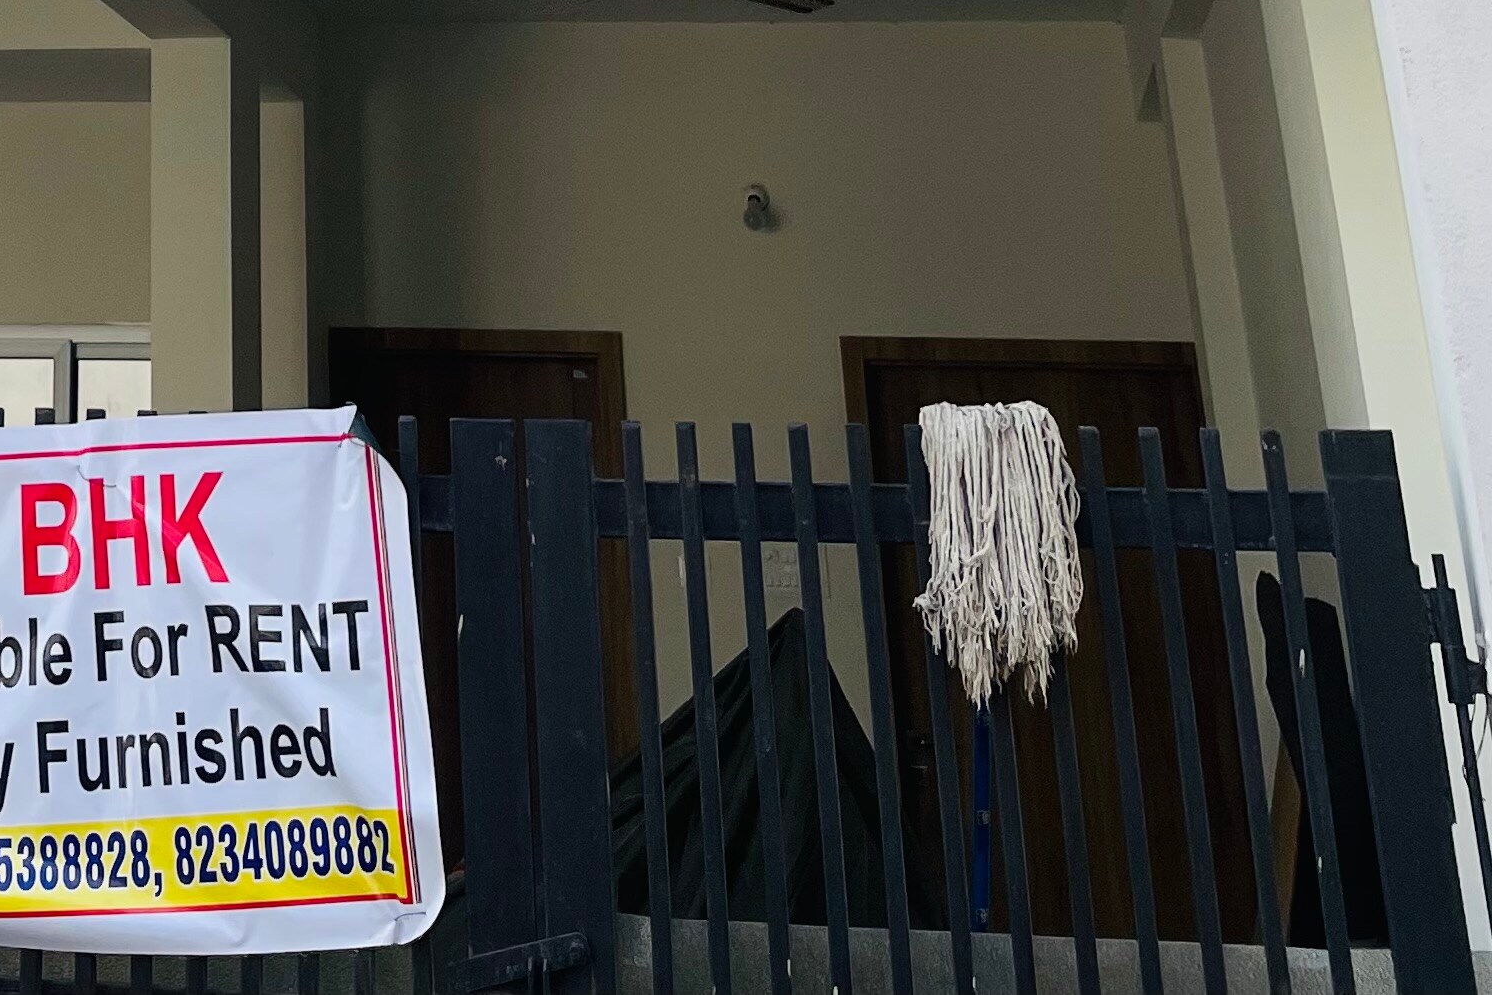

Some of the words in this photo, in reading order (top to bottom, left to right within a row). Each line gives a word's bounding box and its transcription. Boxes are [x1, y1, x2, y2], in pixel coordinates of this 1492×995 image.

[21, 471, 230, 597] BHK
[95, 610, 190, 682] For
[204, 600, 371, 674] RENT
[37, 707, 337, 794] Furnished
[175, 813, 396, 885] 8234089882
